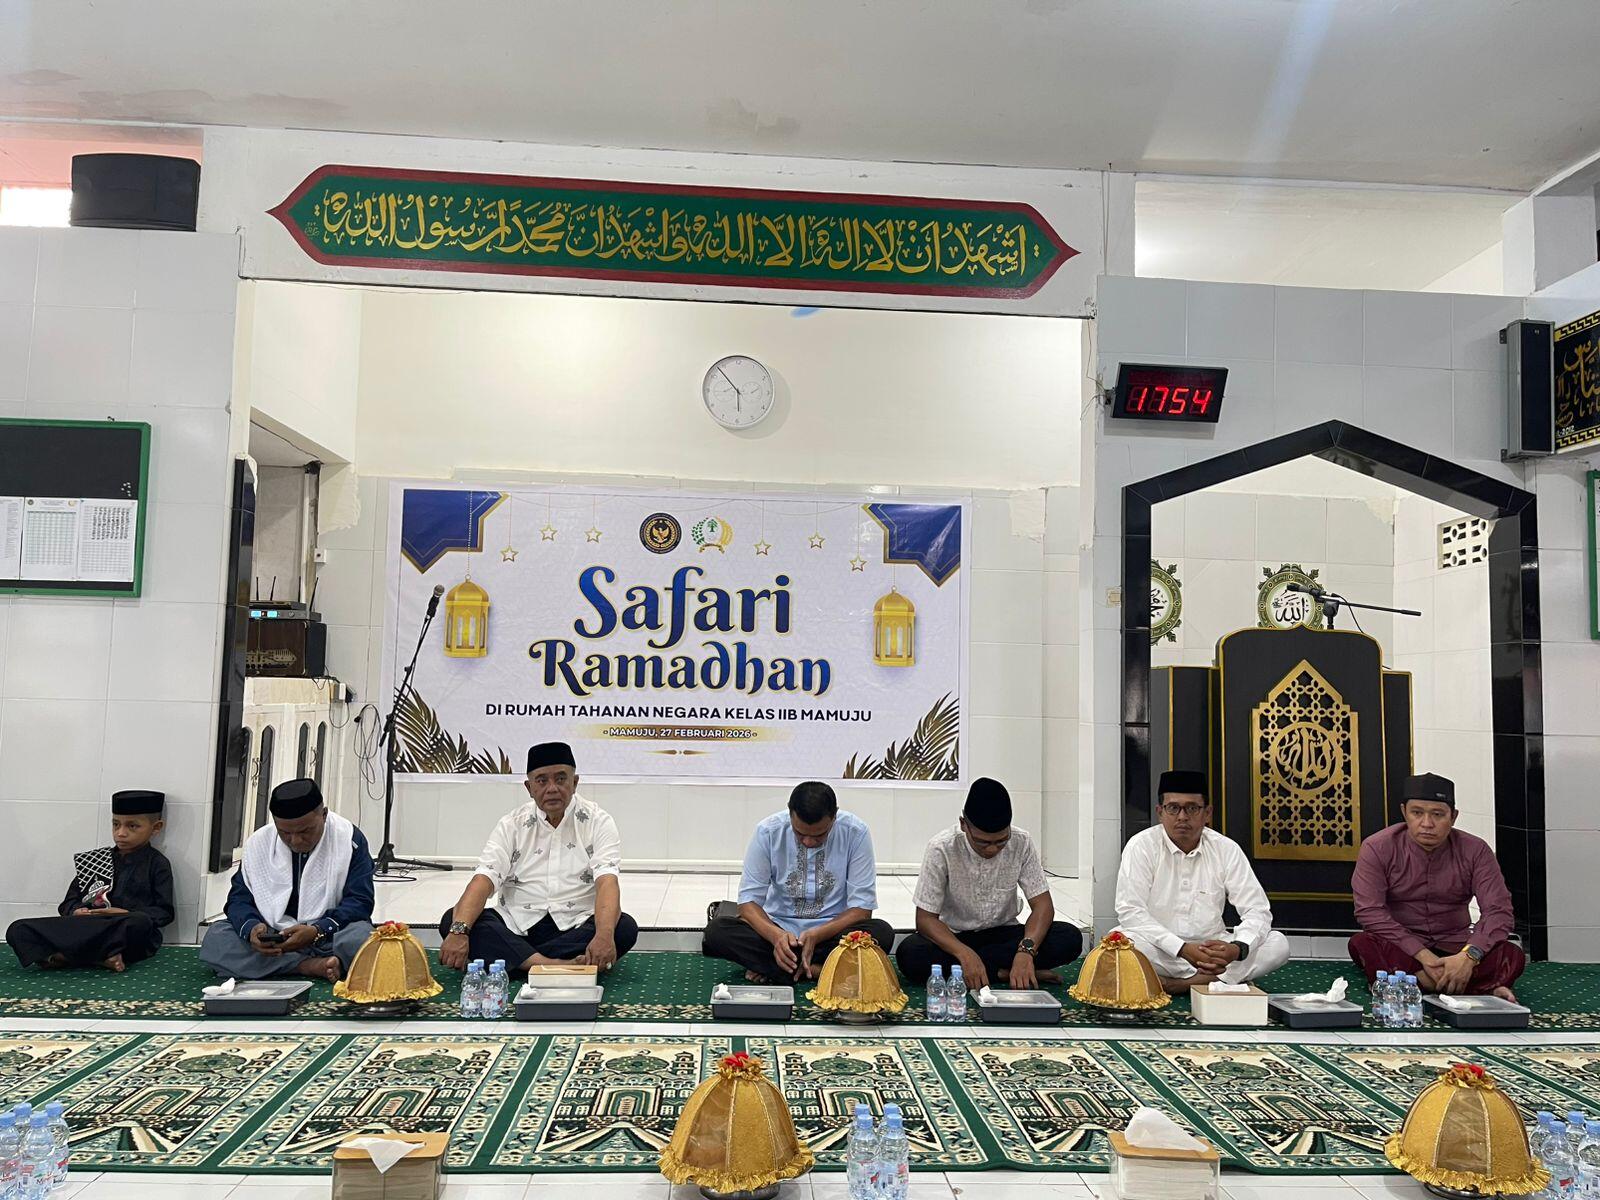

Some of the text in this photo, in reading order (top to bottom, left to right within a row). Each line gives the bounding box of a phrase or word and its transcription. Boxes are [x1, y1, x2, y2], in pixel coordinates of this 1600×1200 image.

[573, 565, 791, 649] Safari
[528, 639, 832, 697] Ramadhan
[486, 704, 872, 722] DI RUMAH TAHANAN NEGARA KELAS IIB MAMUJU
[609, 727, 751, 739] MAMUJU, 27 FEBRUARI 2026
